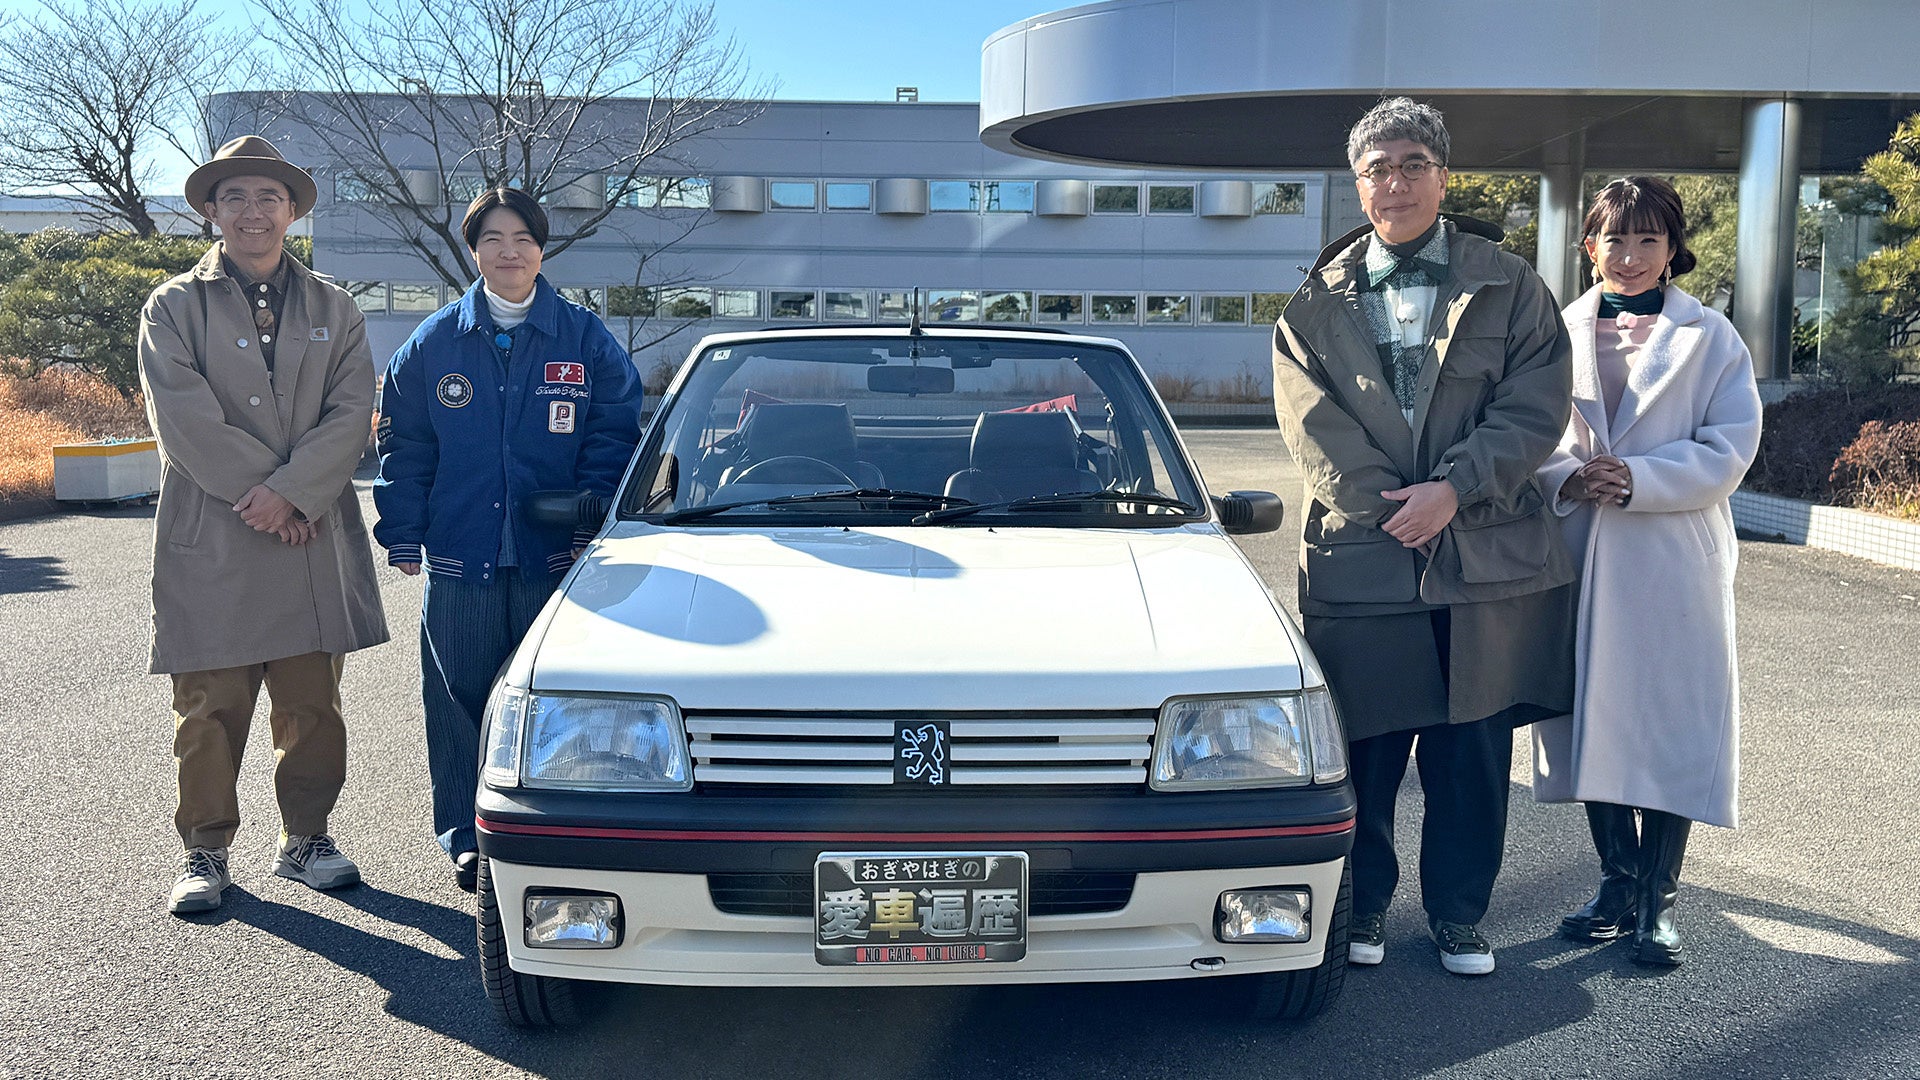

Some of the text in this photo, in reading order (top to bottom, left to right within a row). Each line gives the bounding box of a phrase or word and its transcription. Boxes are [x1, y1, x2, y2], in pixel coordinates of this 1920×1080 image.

[861, 859, 980, 880] おぎやはぎの
[820, 887, 1020, 940] 愛車遍歴
[864, 946, 882, 962] NO
[925, 945, 942, 960] NO
